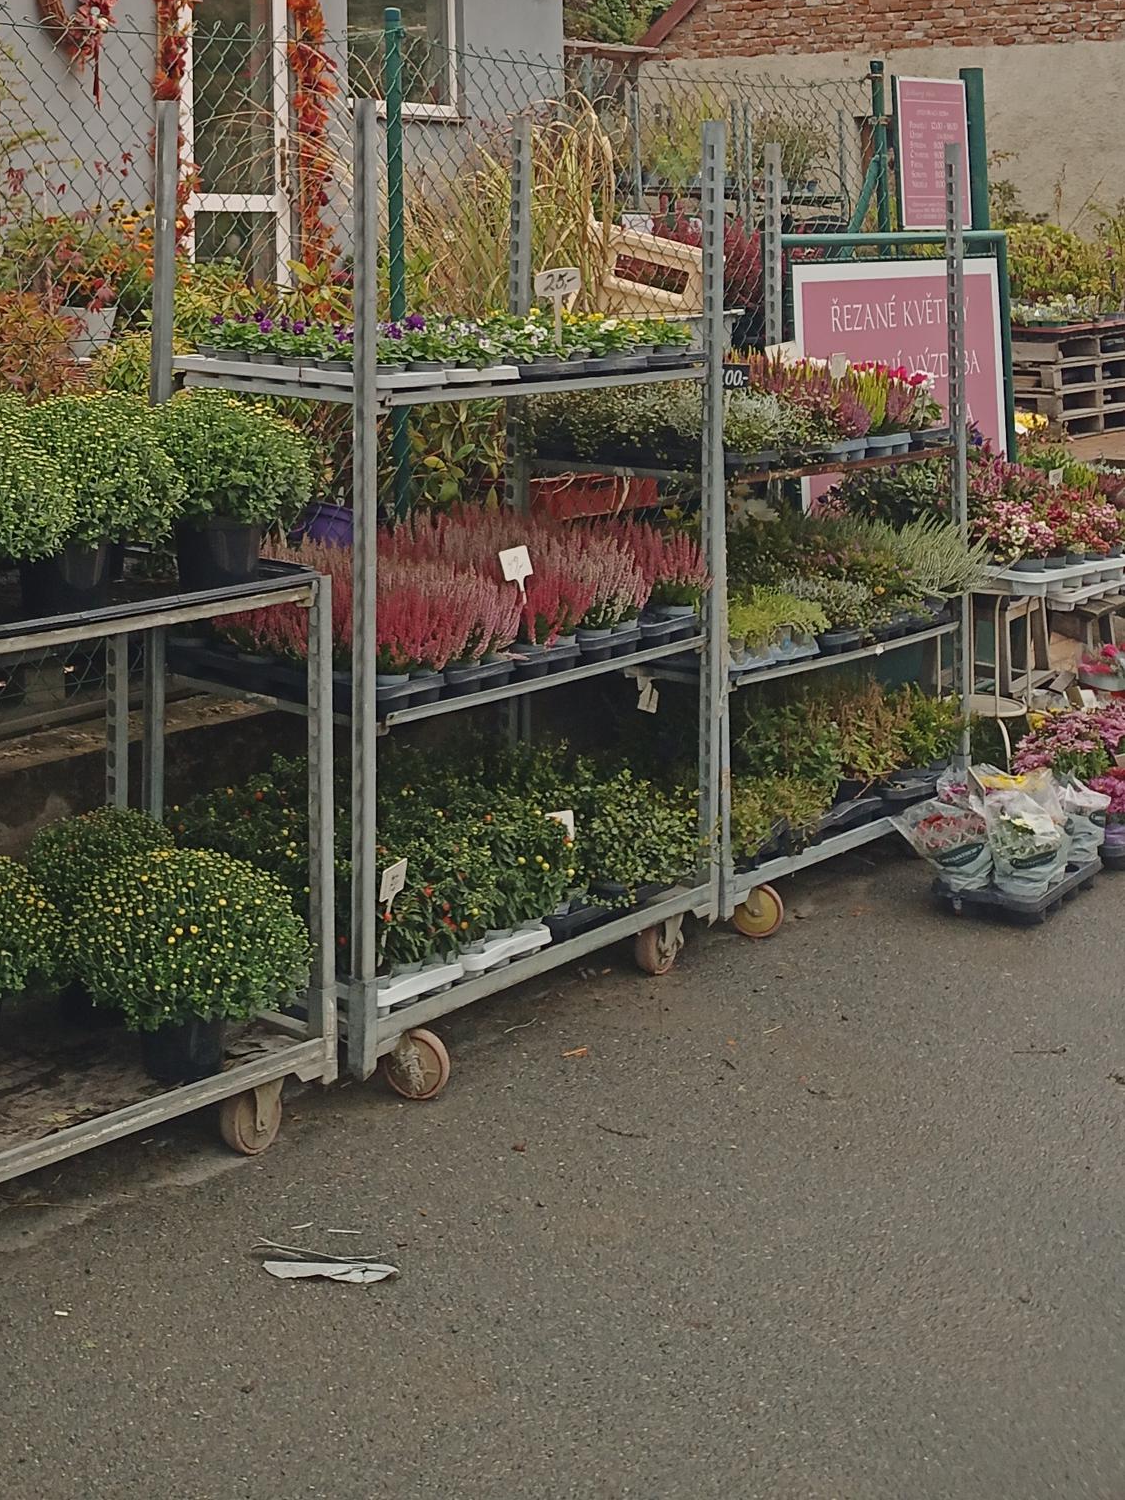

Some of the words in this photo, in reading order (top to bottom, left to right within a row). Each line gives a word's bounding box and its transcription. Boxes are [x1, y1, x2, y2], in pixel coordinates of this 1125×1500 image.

[543, 272, 577, 292] 25,-
[830, 294, 897, 333] ŘEZANÉ
[903, 292, 969, 327] KVĚTIY
[908, 346, 981, 378] VÝZDBA
[722, 369, 749, 387] 00,-
